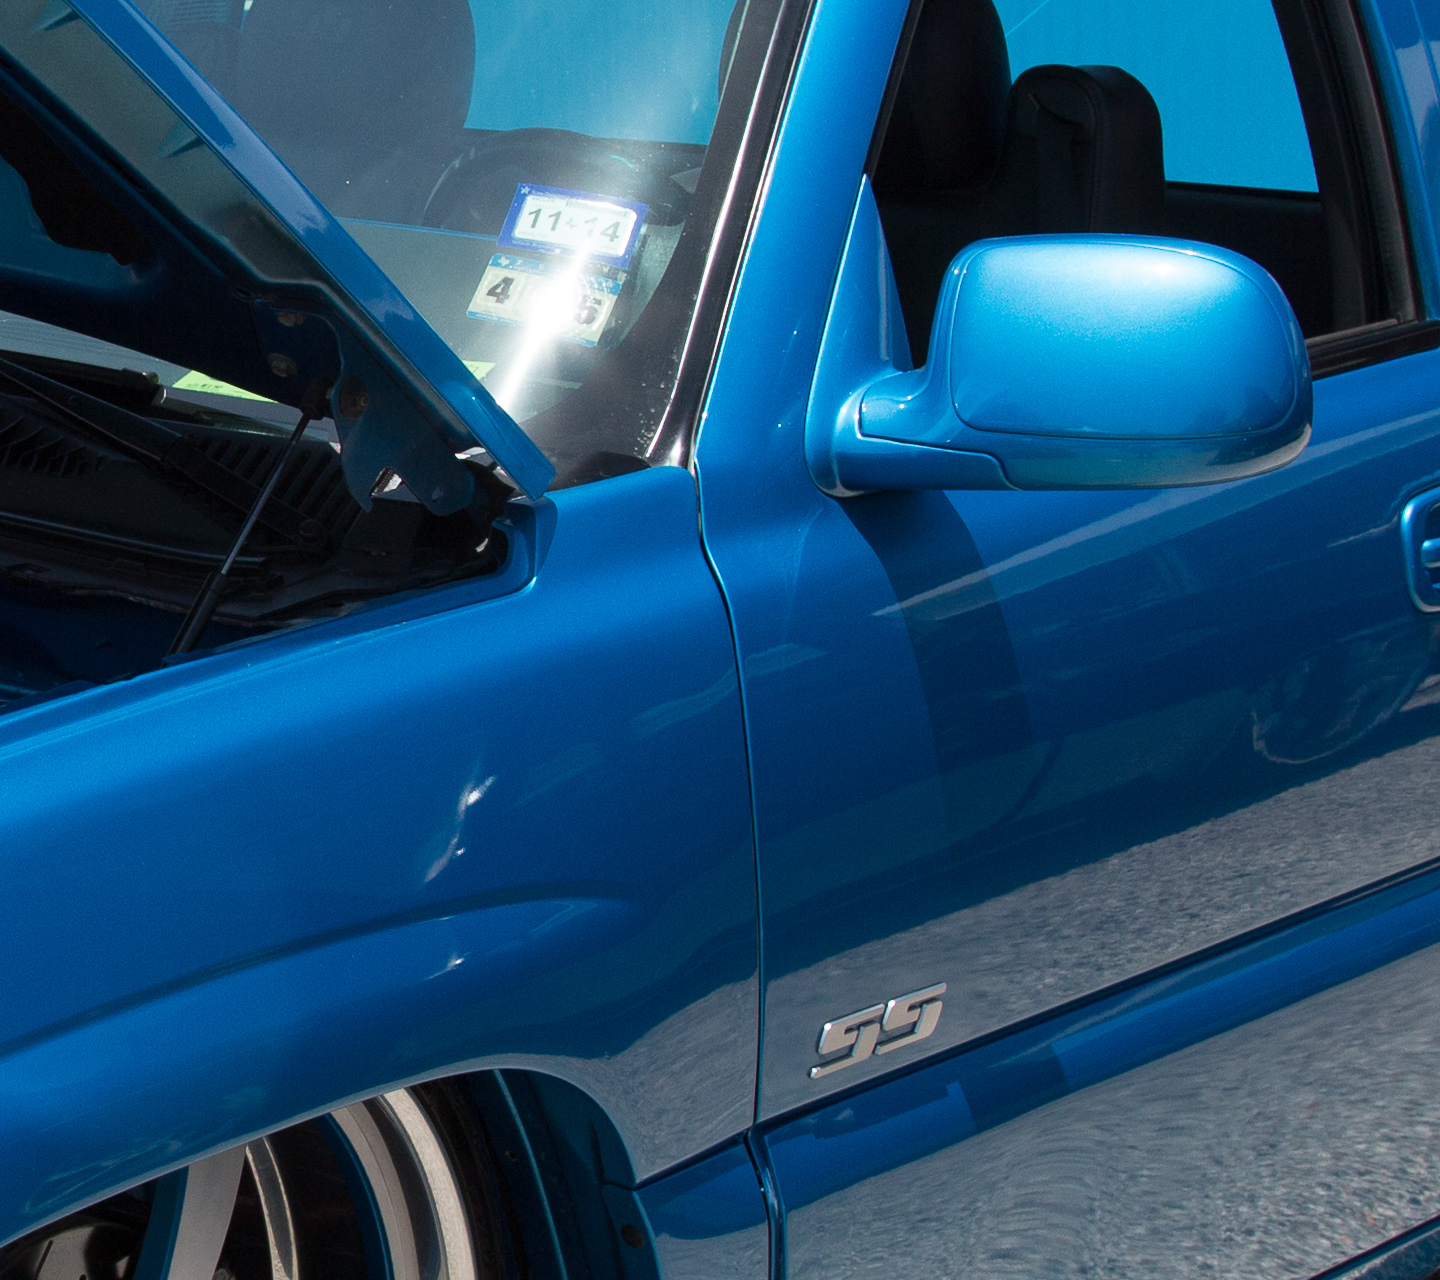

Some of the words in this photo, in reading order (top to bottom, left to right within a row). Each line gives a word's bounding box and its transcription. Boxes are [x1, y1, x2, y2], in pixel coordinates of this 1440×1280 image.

[528, 207, 563, 232] 11
[584, 217, 622, 243] 14
[486, 276, 516, 305] 4
[809, 982, 947, 1079] SS
